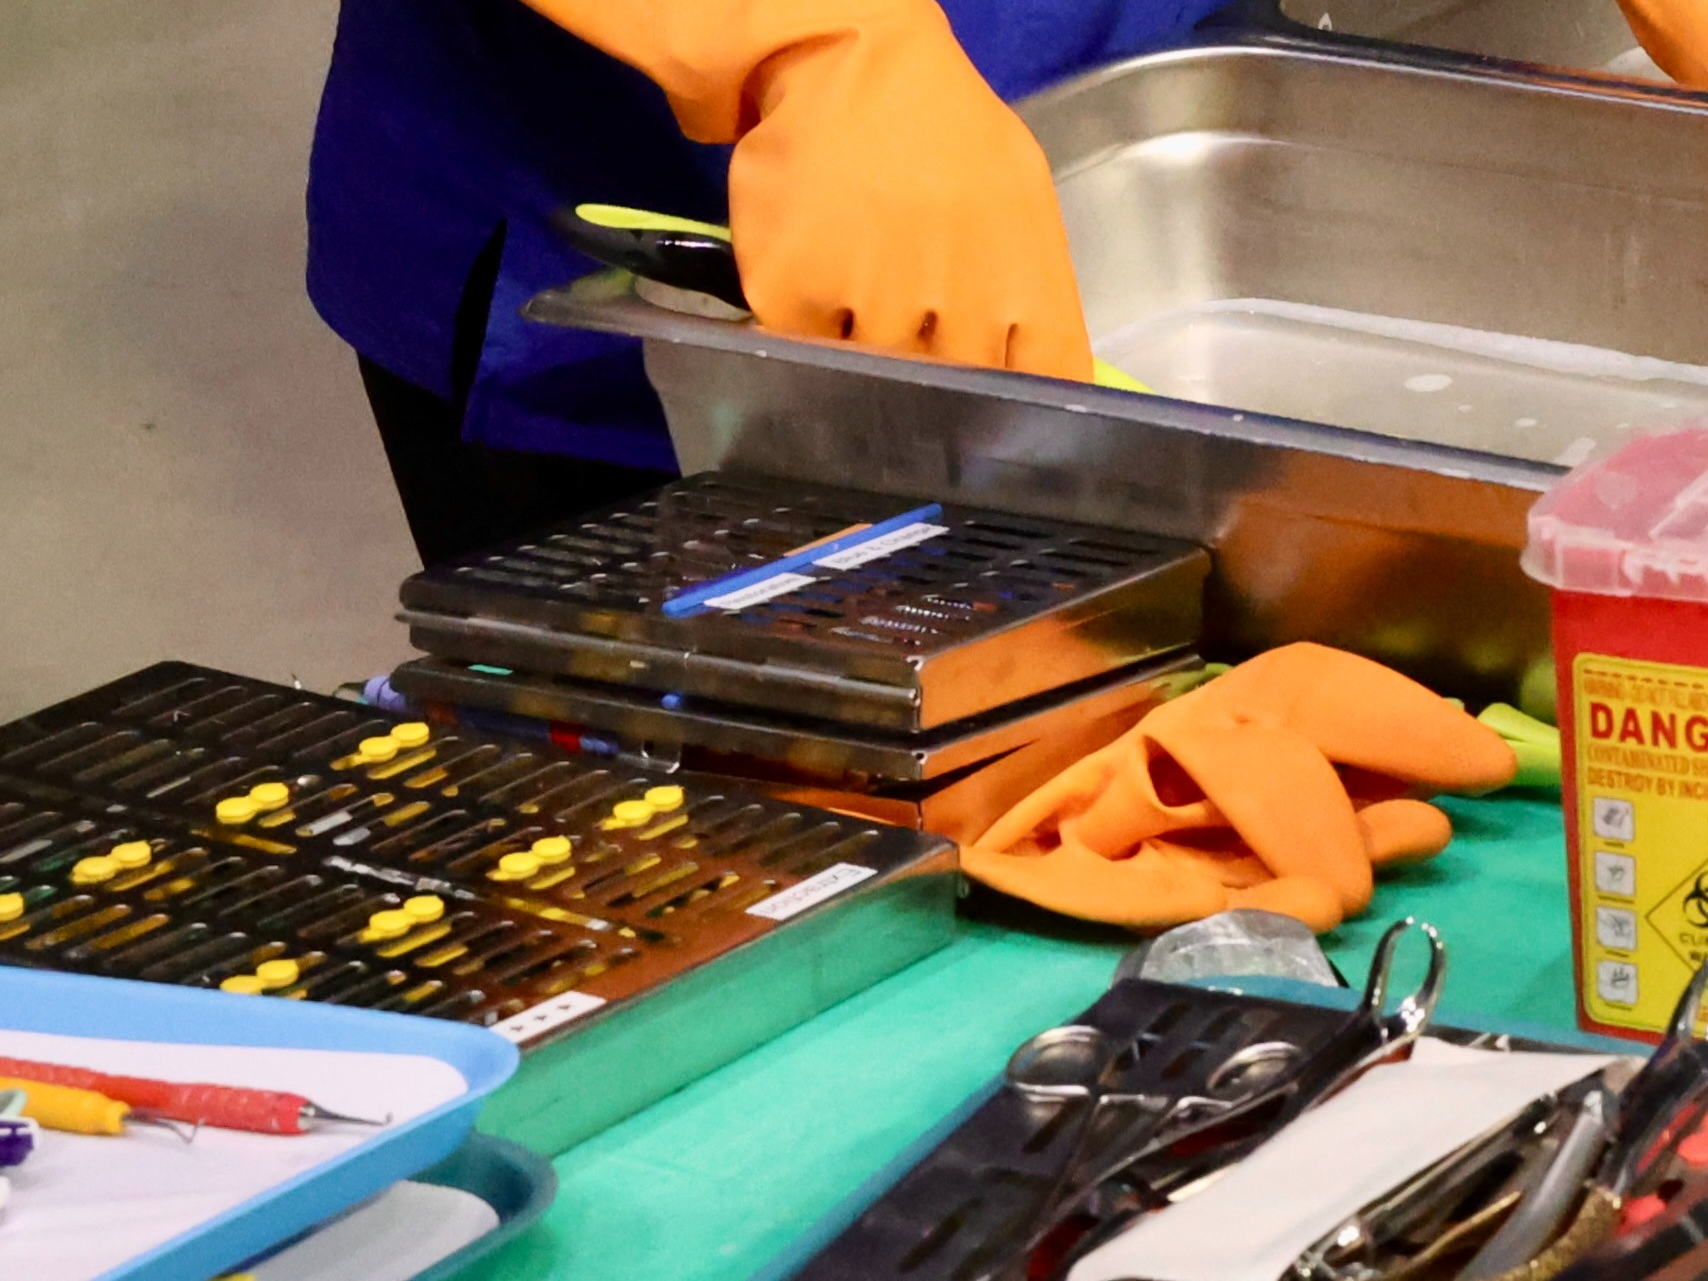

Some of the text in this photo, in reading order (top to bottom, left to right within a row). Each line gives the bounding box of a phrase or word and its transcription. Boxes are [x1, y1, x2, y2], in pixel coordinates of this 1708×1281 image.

[1586, 743, 1690, 776] CONTAMINATED
[1587, 766, 1653, 794] DESTROY
[1656, 777, 1676, 797] BY
